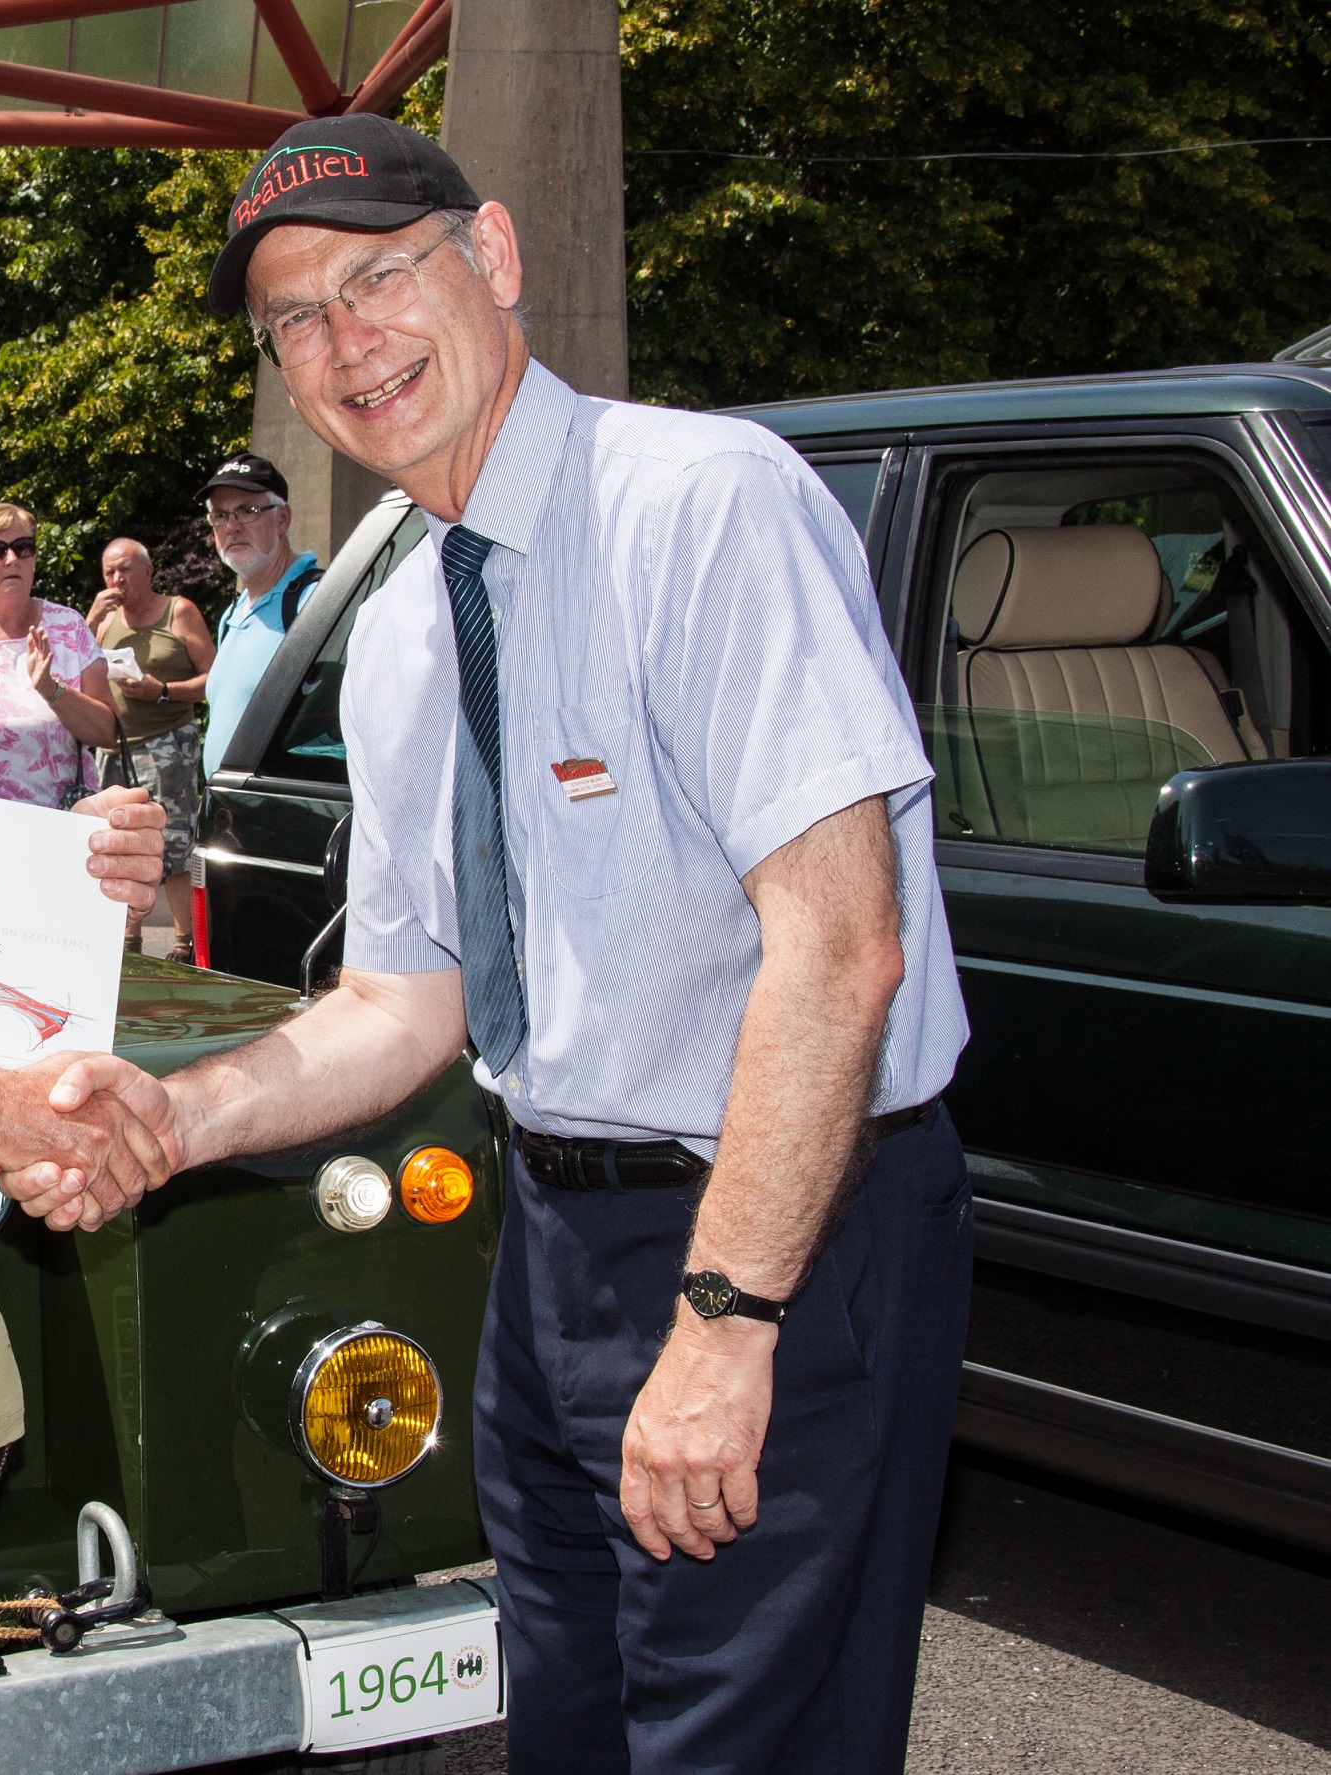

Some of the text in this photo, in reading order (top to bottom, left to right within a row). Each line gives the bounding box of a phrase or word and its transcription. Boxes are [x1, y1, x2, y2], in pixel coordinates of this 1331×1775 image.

[234, 152, 369, 229] Beaulieu
[22, 931, 91, 950] EXCELLENCE
[450, 1644, 489, 1672] THE LAND ROVER
[329, 1651, 449, 1719] 1964
[452, 1677, 470, 1690] SERIES
[475, 1671, 488, 1687] CLUB
